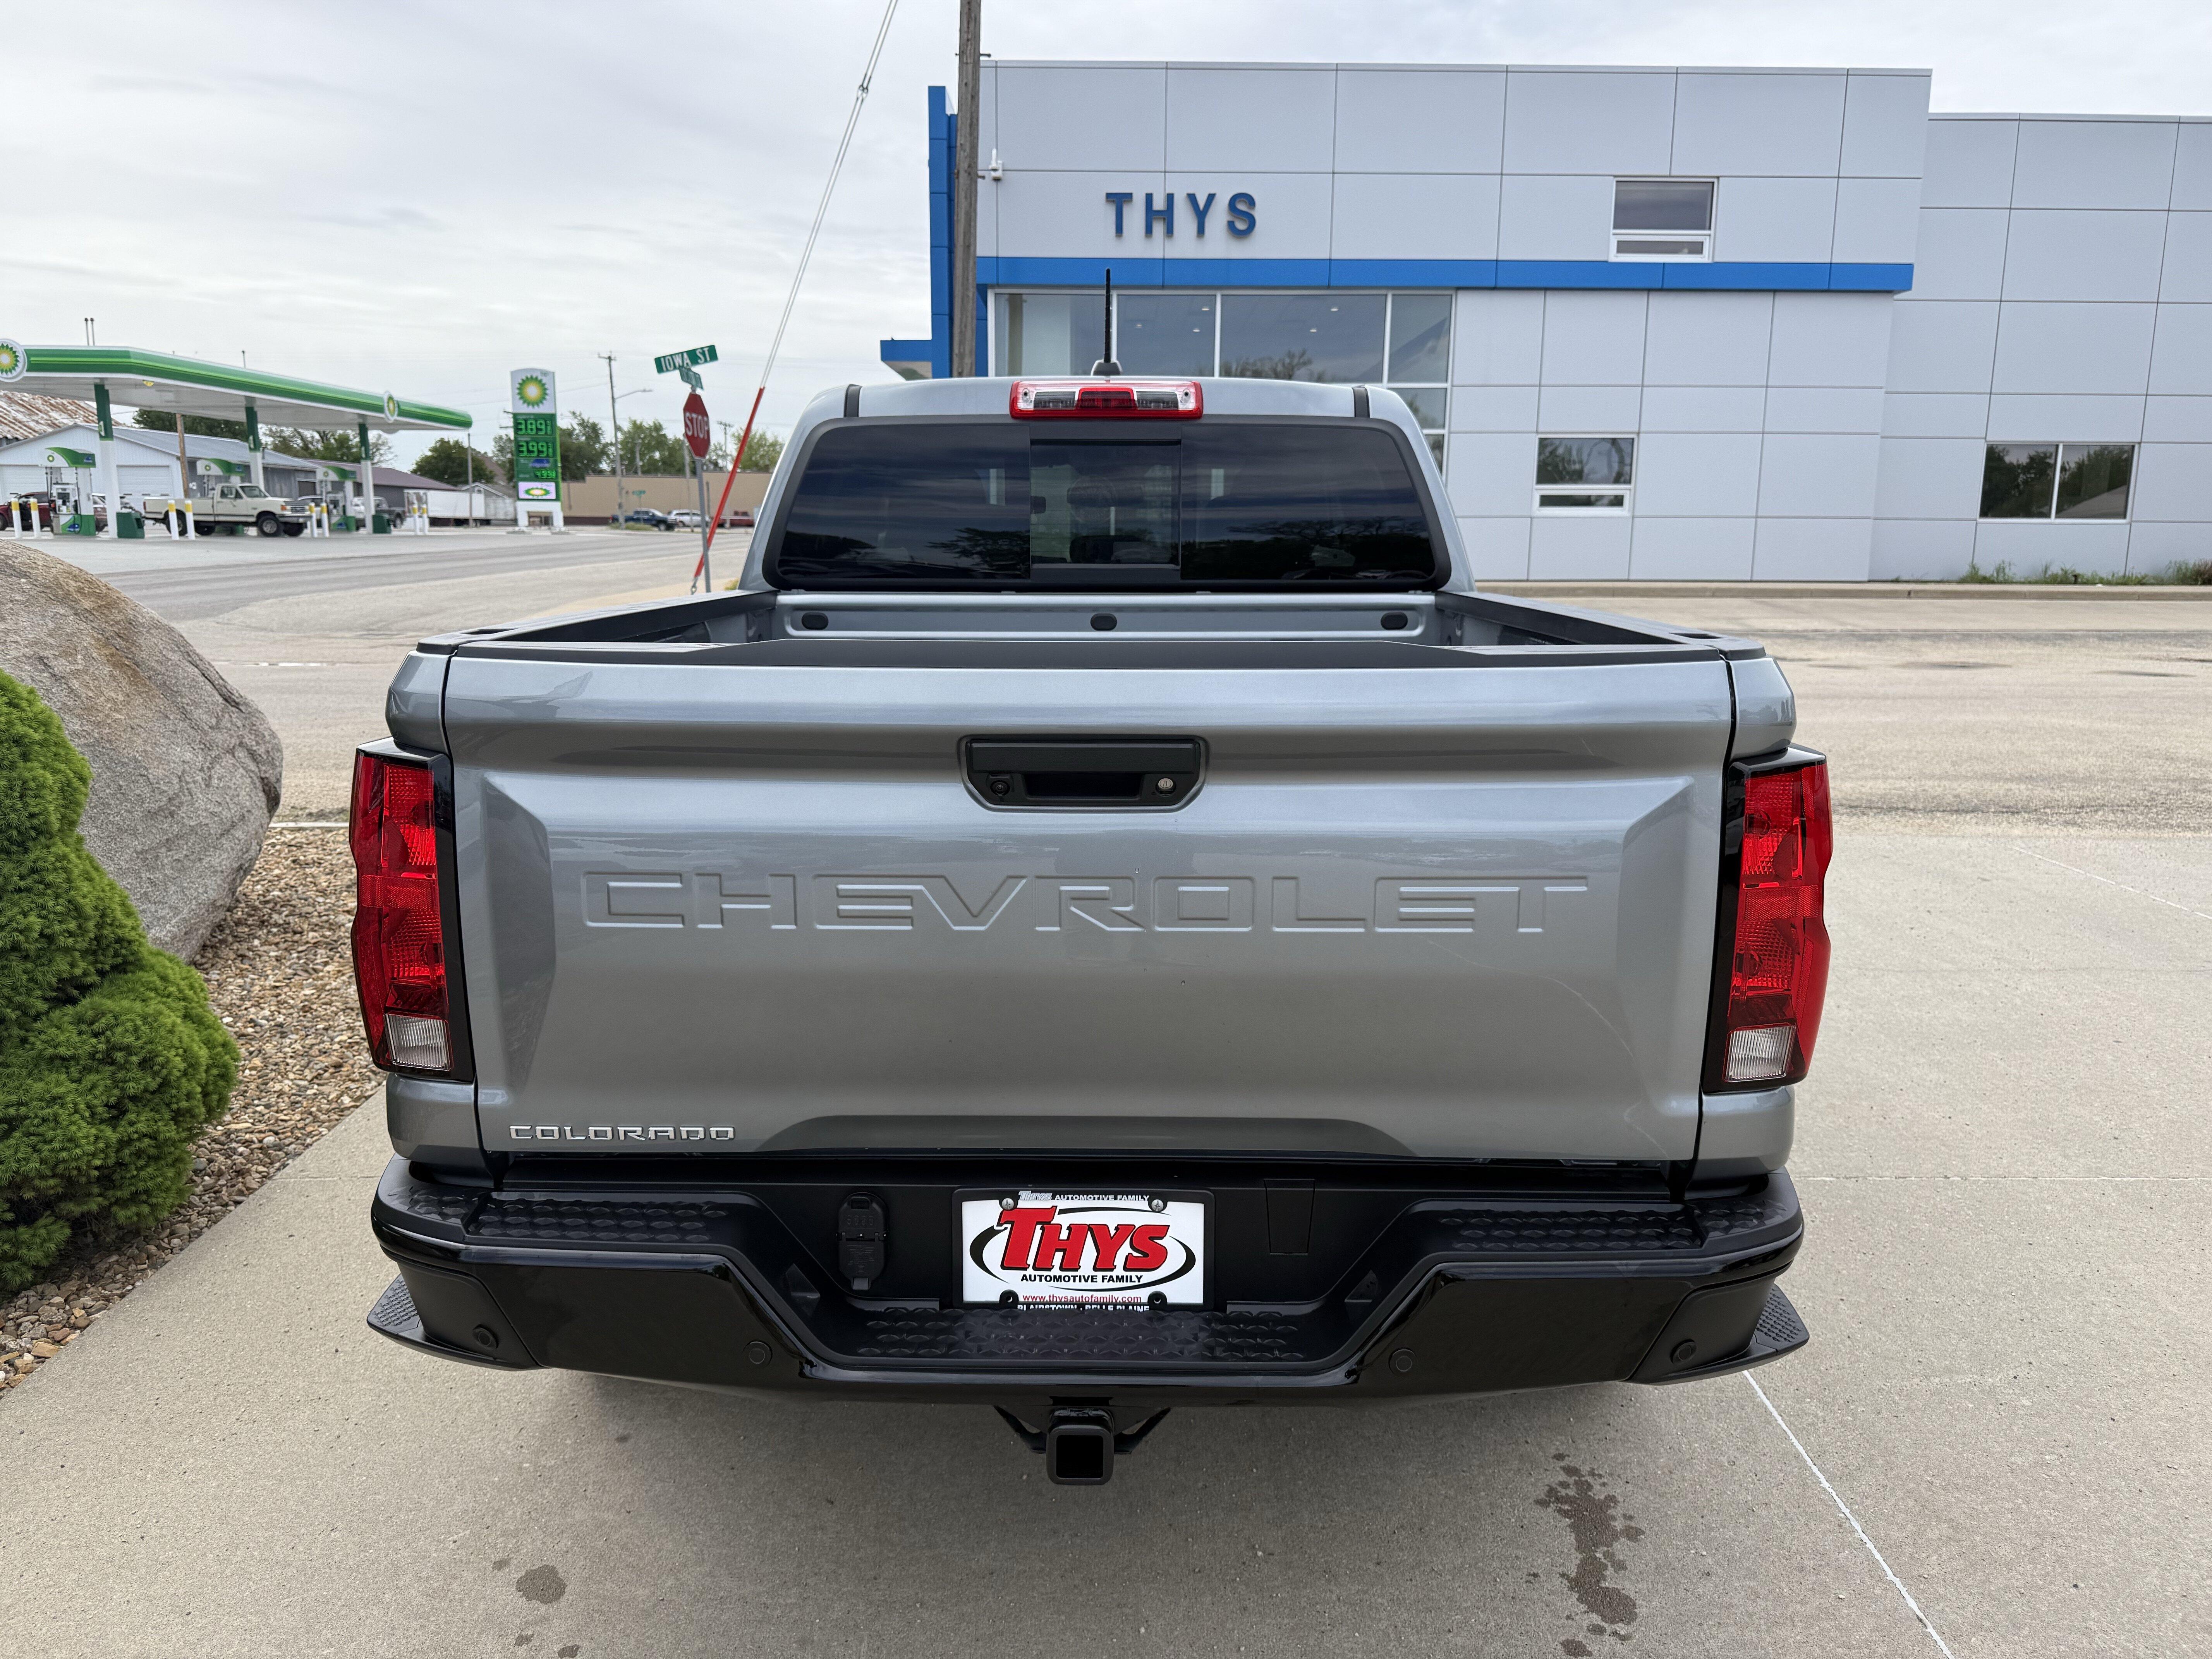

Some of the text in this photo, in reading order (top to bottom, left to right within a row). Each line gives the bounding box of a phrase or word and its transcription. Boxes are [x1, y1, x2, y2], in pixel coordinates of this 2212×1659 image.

[1106, 192, 1256, 237] THYS
[660, 347, 710, 372] IOWA ST
[685, 412, 709, 440] STOP
[582, 872, 1588, 932] CHEVROLET
[509, 1125, 735, 1140] COLORADO
[996, 1205, 1170, 1272] THYS
[1021, 1274, 1143, 1283] AUTOMOTIVE FAMILY
[1023, 1294, 1142, 1303] www.thysautofamily.com
